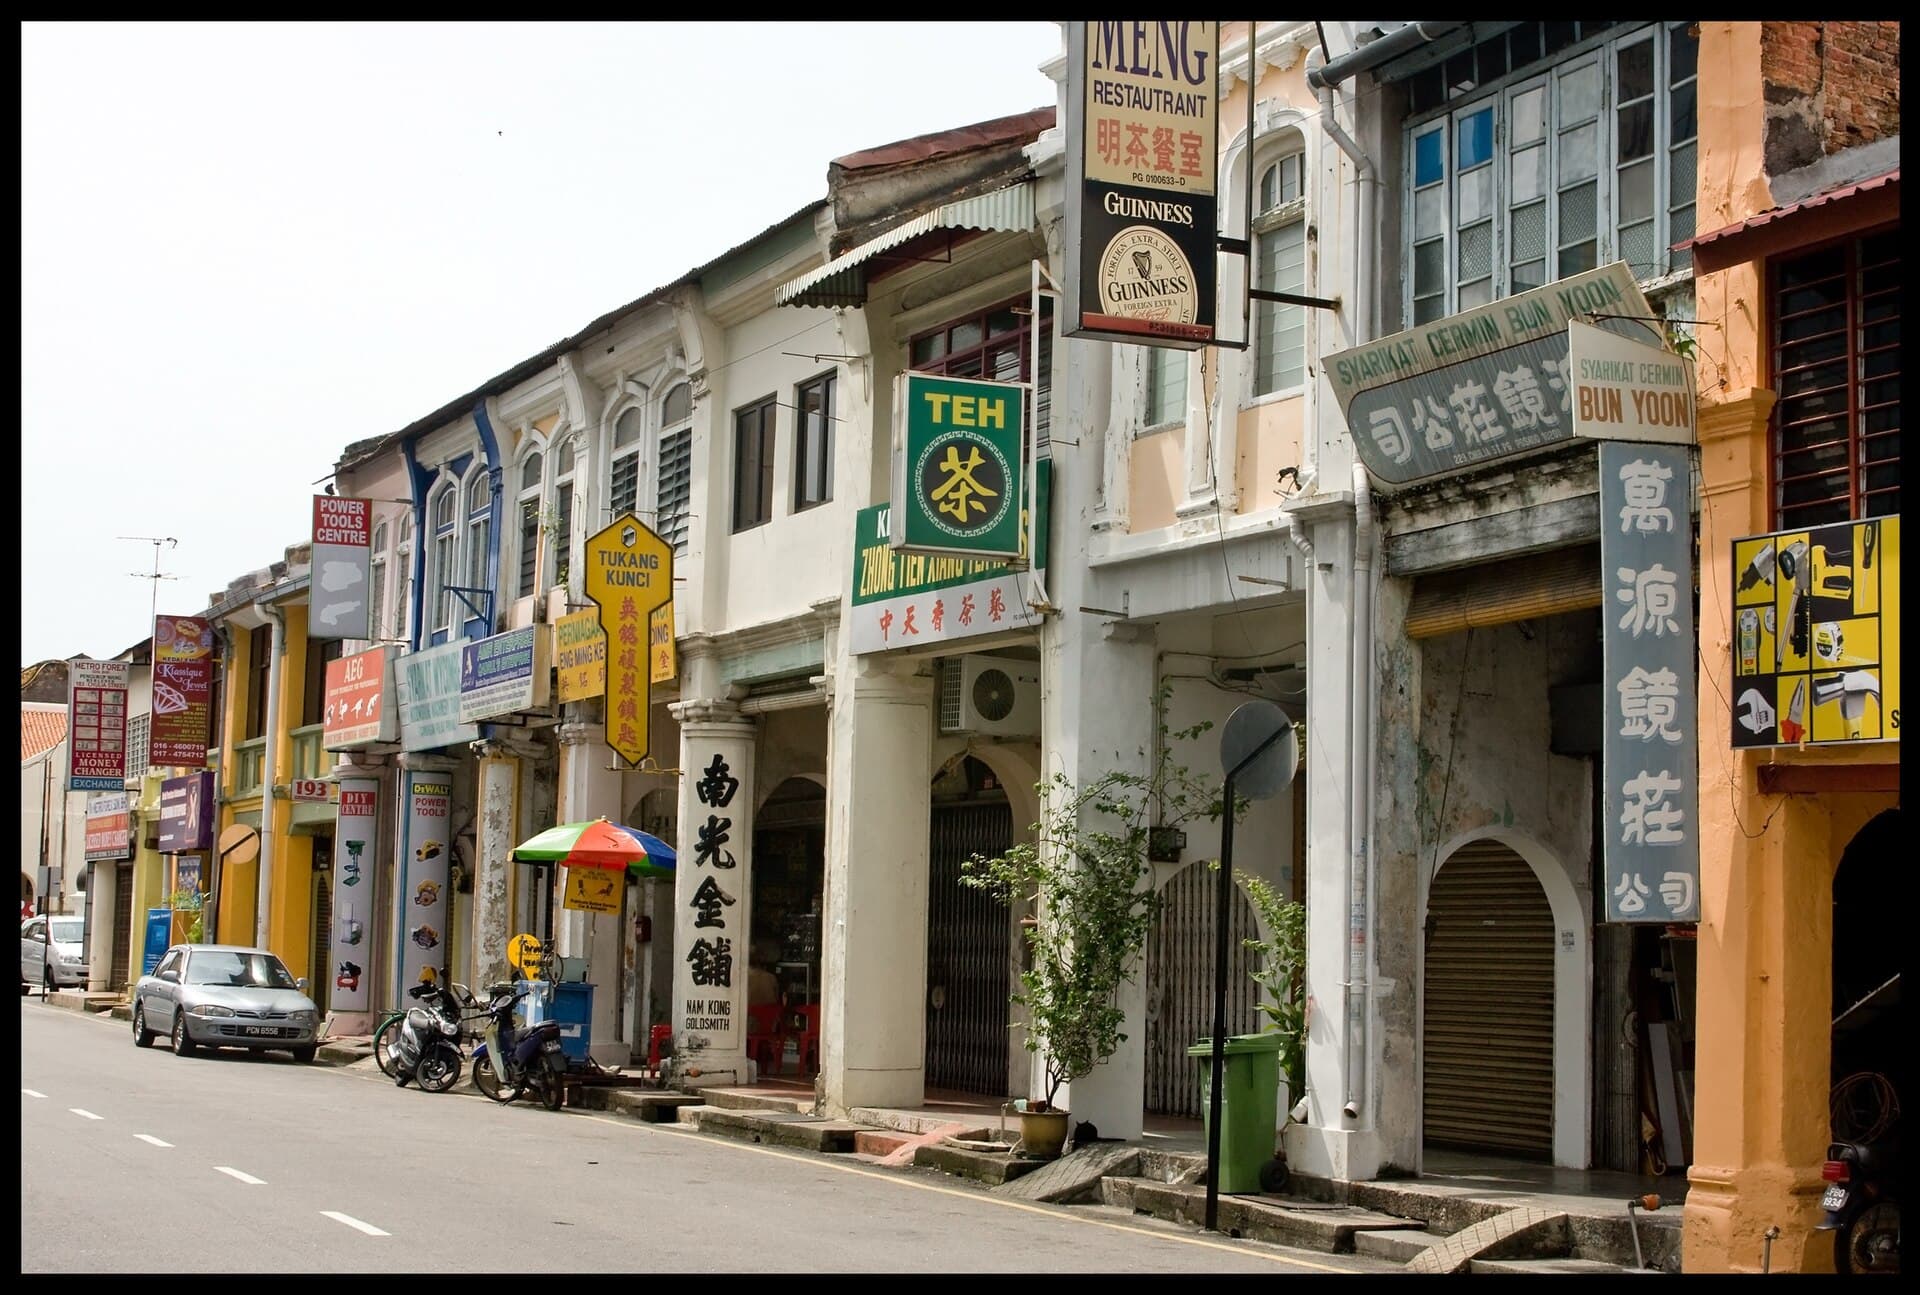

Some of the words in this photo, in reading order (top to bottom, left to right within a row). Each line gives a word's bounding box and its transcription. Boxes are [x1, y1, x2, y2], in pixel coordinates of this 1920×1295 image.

[1092, 21, 1208, 85] MENG
[1094, 80, 1207, 118] RESTAUTRANT
[1097, 118, 1203, 178] 明茶餐室
[1132, 172, 1144, 183] PG
[1104, 191, 1193, 225] GUINNESS
[1107, 242, 1127, 277] FOREIGN
[1131, 235, 1159, 247] EXTRA
[1162, 245, 1182, 270] STOUT
[1108, 276, 1188, 302] GUINNESS
[1124, 301, 1153, 311] FOREIGN
[1154, 299, 1177, 308] EXTRA
[1336, 337, 1420, 385] SYARIKAT
[1426, 313, 1501, 357] CERMIN
[1505, 299, 1554, 333] BUN
[1558, 275, 1622, 315] YOON
[1580, 359, 1634, 384] SYARIKAT
[1639, 361, 1684, 386] CERMIN
[924, 392, 1005, 429] TEH
[1579, 386, 1623, 424] BUN
[1631, 389, 1690, 428] YOON
[931, 446, 998, 523] 茶
[320, 499, 364, 515] POWER
[321, 513, 363, 529] TOOLS
[317, 528, 367, 544] CENTRE
[598, 550, 659, 570] TUKANG
[606, 569, 650, 588] KUNCI
[859, 544, 896, 598] ZHONG
[560, 650, 573, 670] ENG
[574, 645, 592, 667] MING
[594, 641, 606, 661] KE
[74, 662, 100, 671] METRO
[102, 664, 127, 673] FOREX
[157, 664, 204, 683] Klassique
[343, 657, 364, 684] AEG
[181, 679, 208, 691] Jewel
[75, 751, 122, 759] LICENSED
[79, 759, 119, 768] MONEY
[74, 767, 122, 777] CHANGER
[73, 779, 123, 790] EXCHANGE
[295, 781, 327, 797] 193
[347, 793, 369, 804] DIY
[415, 798, 447, 808] POWER
[341, 804, 375, 816] CENTRE
[416, 808, 446, 817] TOOLS
[1614, 871, 1694, 914] 公司
[686, 999, 704, 1015] NAM
[707, 999, 731, 1016] KONG
[685, 1017, 730, 1031] GOLDSMITH
